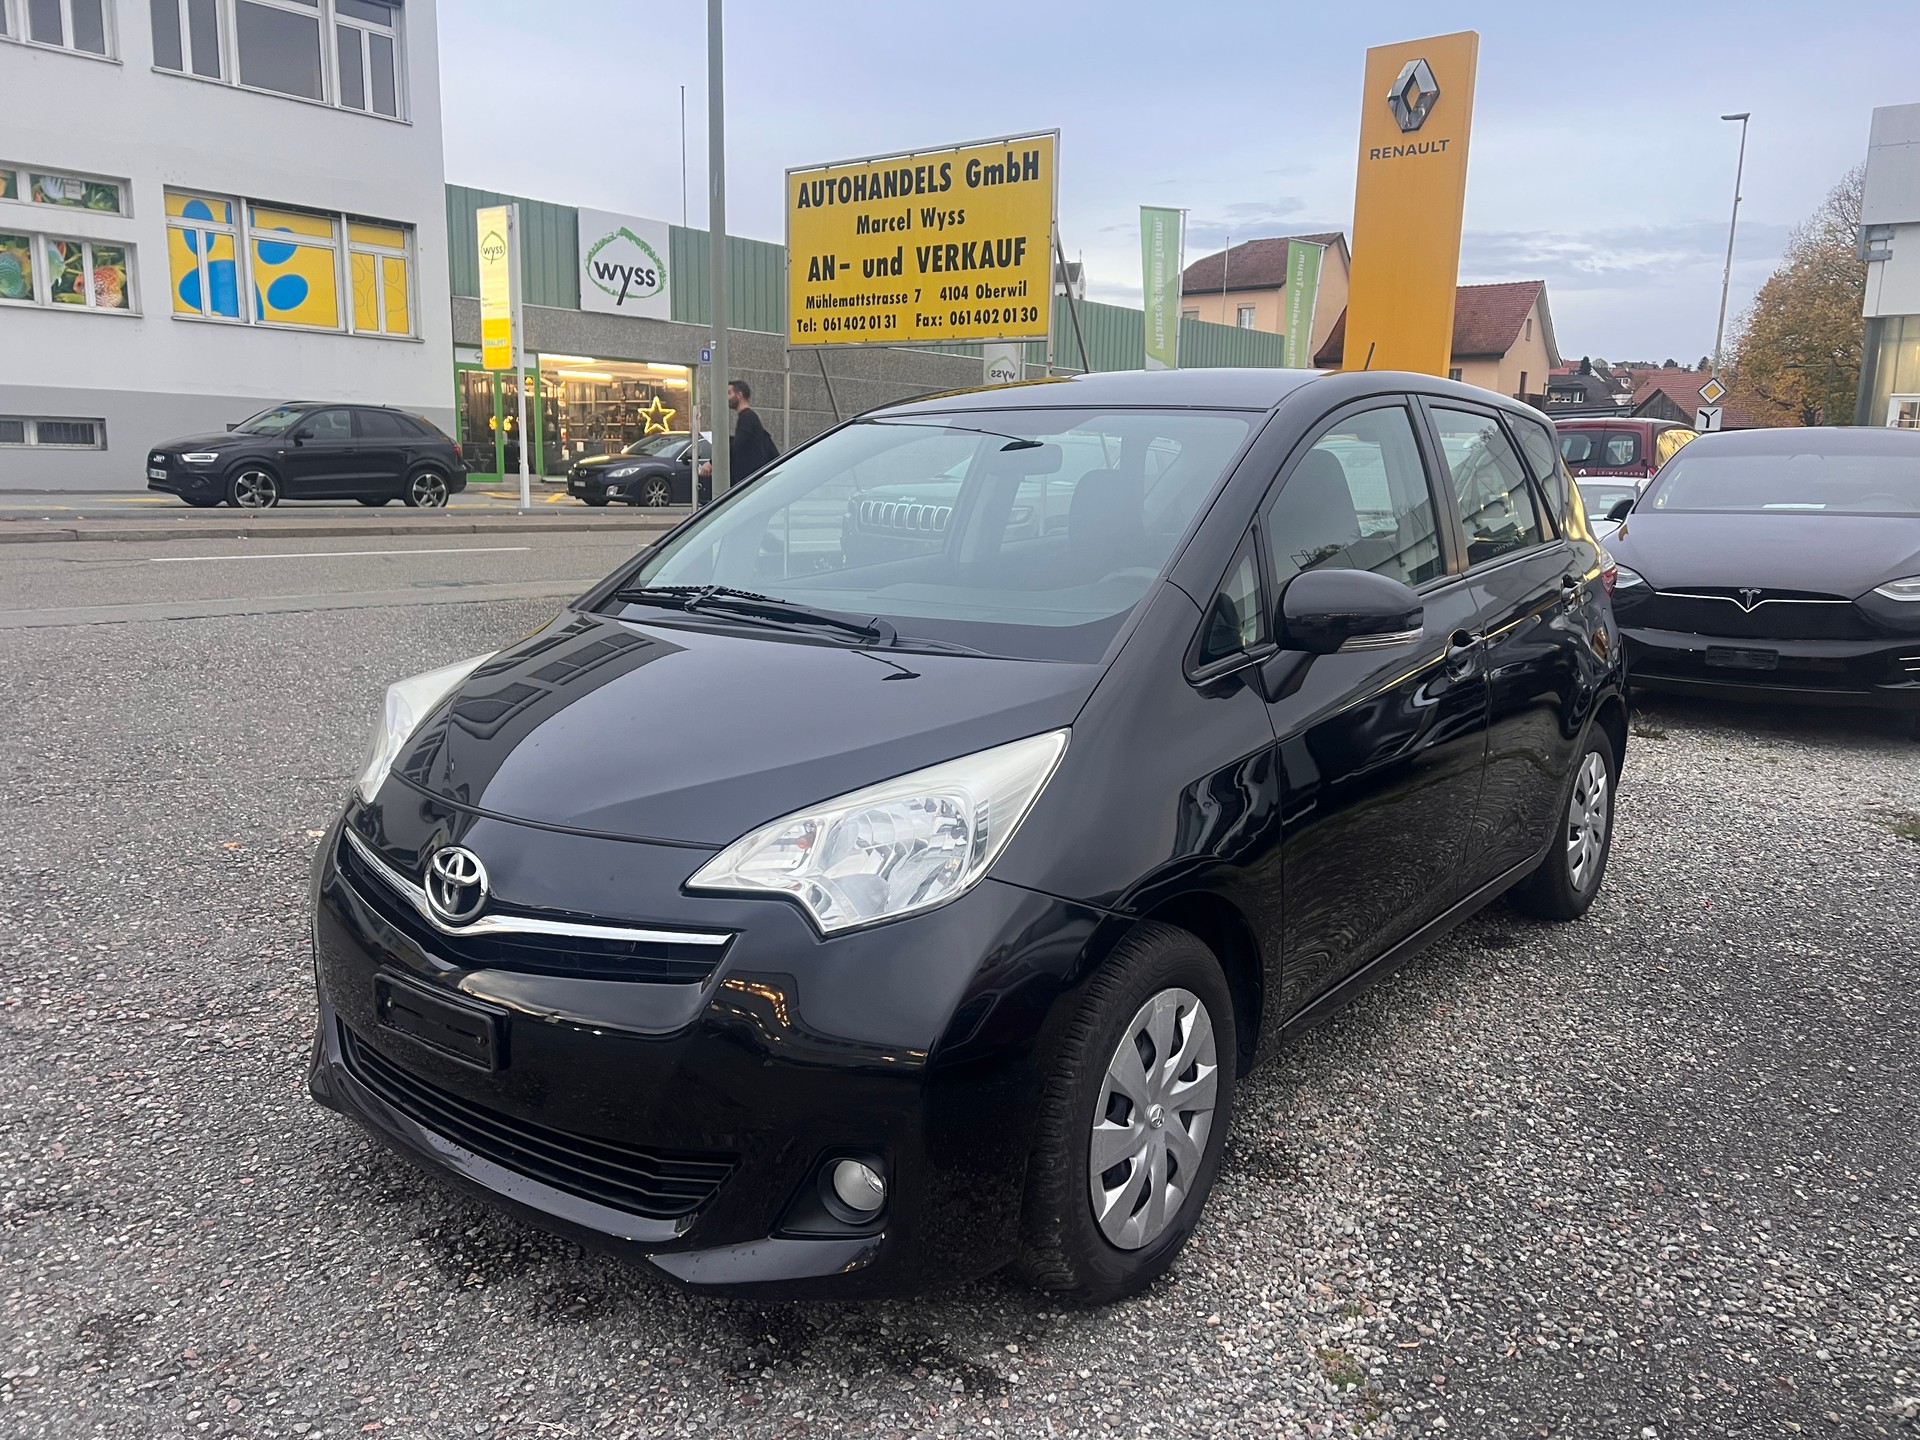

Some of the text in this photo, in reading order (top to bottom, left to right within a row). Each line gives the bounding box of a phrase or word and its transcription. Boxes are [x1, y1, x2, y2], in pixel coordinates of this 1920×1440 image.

[1370, 139, 1450, 160] RENAULT
[797, 150, 1040, 209] AUTOHANDELS GmbH
[856, 206, 965, 235] Marcel Wyss
[483, 245, 504, 265] wyss
[807, 237, 1027, 282] AN- und VERKAUF
[593, 261, 656, 306] wyss
[806, 280, 1028, 309] Mühlemattstrasse 7 4104 Oberwil
[797, 318, 817, 332] Tel:
[915, 313, 942, 327] Fax:
